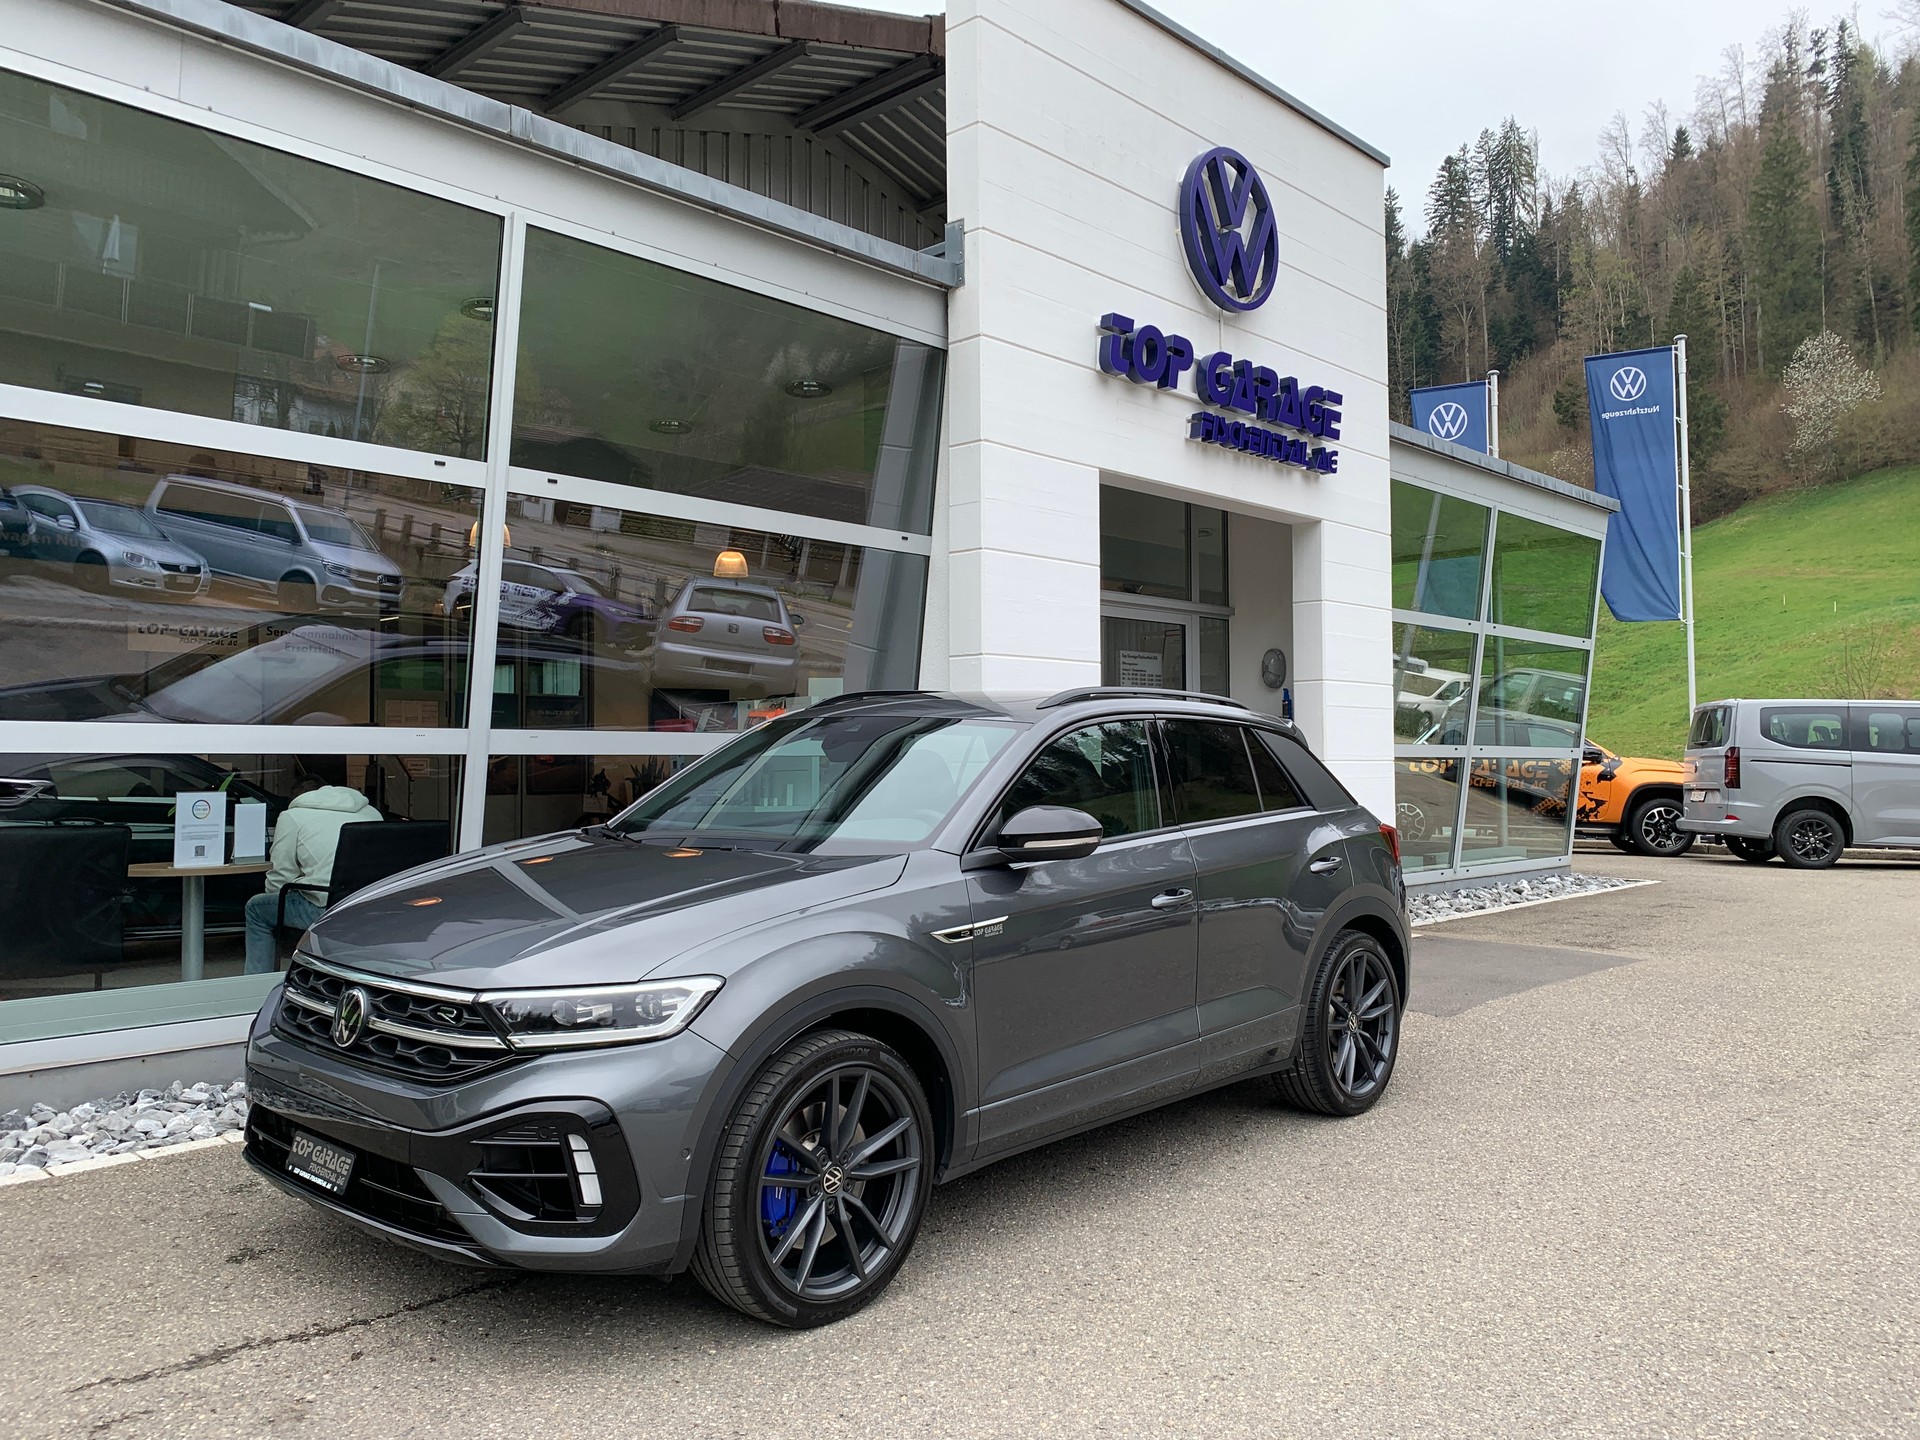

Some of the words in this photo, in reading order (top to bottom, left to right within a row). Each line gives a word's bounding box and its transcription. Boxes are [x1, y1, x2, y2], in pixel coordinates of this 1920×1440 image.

[1098, 312, 1195, 391] TOP
[1196, 351, 1344, 442] GARAGE
[1190, 411, 1310, 470] FISCHENTHAL
[292, 1136, 314, 1157] TOP
[311, 1145, 352, 1176] GARAGE
